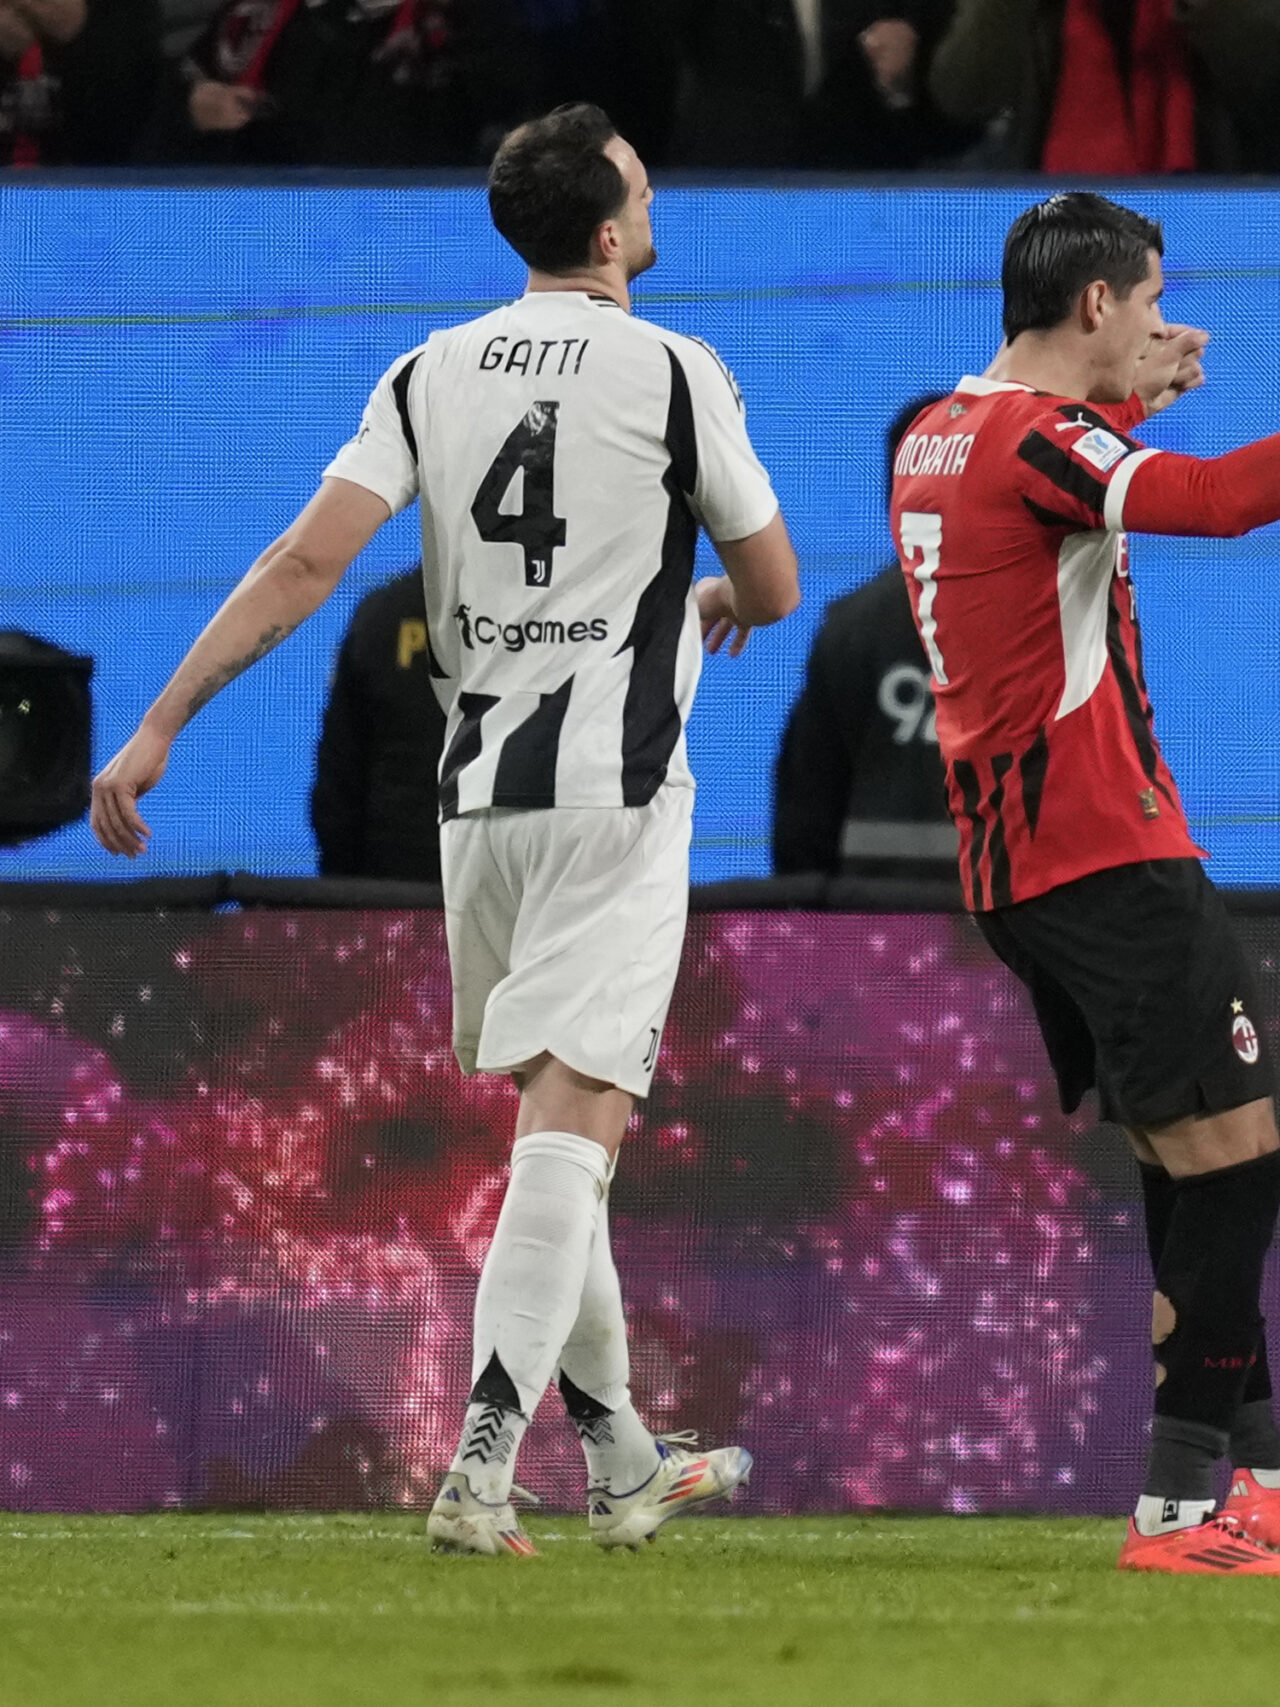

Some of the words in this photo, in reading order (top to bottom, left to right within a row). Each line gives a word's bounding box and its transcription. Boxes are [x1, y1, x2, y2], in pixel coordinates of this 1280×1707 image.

[479, 335, 591, 376] GATTI
[894, 433, 976, 476] MORATA
[470, 400, 567, 588] 4
[900, 511, 949, 686] 7
[474, 615, 609, 653] Cgames
